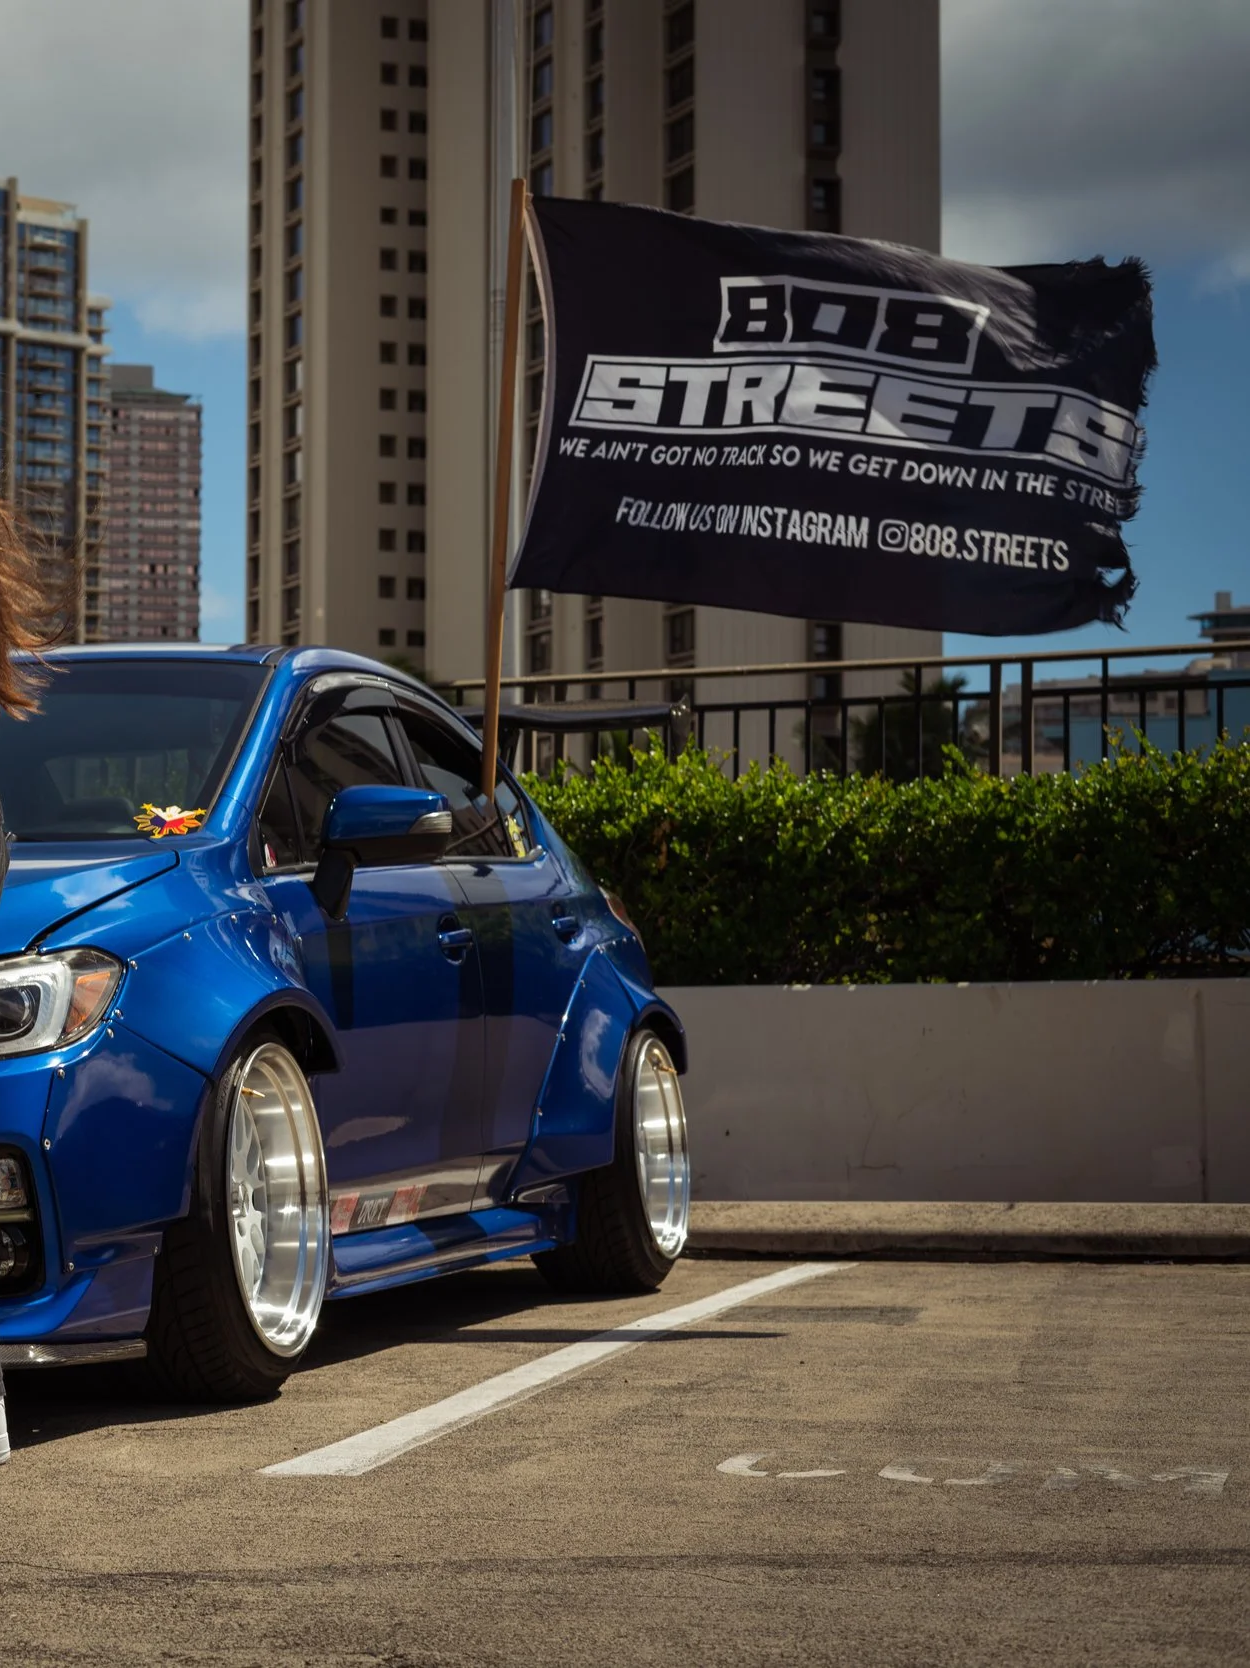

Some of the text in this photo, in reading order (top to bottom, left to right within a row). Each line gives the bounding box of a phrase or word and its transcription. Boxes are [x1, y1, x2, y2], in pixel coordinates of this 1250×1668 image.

[714, 276, 989, 374] 808
[573, 360, 1136, 484] STREETS
[558, 437, 590, 458] WE
[591, 441, 648, 462] AIN'T
[650, 444, 691, 466] GOT
[692, 446, 717, 466] NO
[719, 444, 766, 466] TRACK
[768, 444, 801, 467] SO
[808, 448, 844, 472] WE
[848, 453, 898, 478] GET
[901, 460, 977, 489] DOWN
[980, 468, 1010, 491] IN
[1015, 471, 1059, 496] THE
[615, 496, 692, 532] FOLLOW
[689, 504, 714, 532] US
[715, 504, 739, 535] ON
[739, 505, 870, 548] INSTAGRAM
